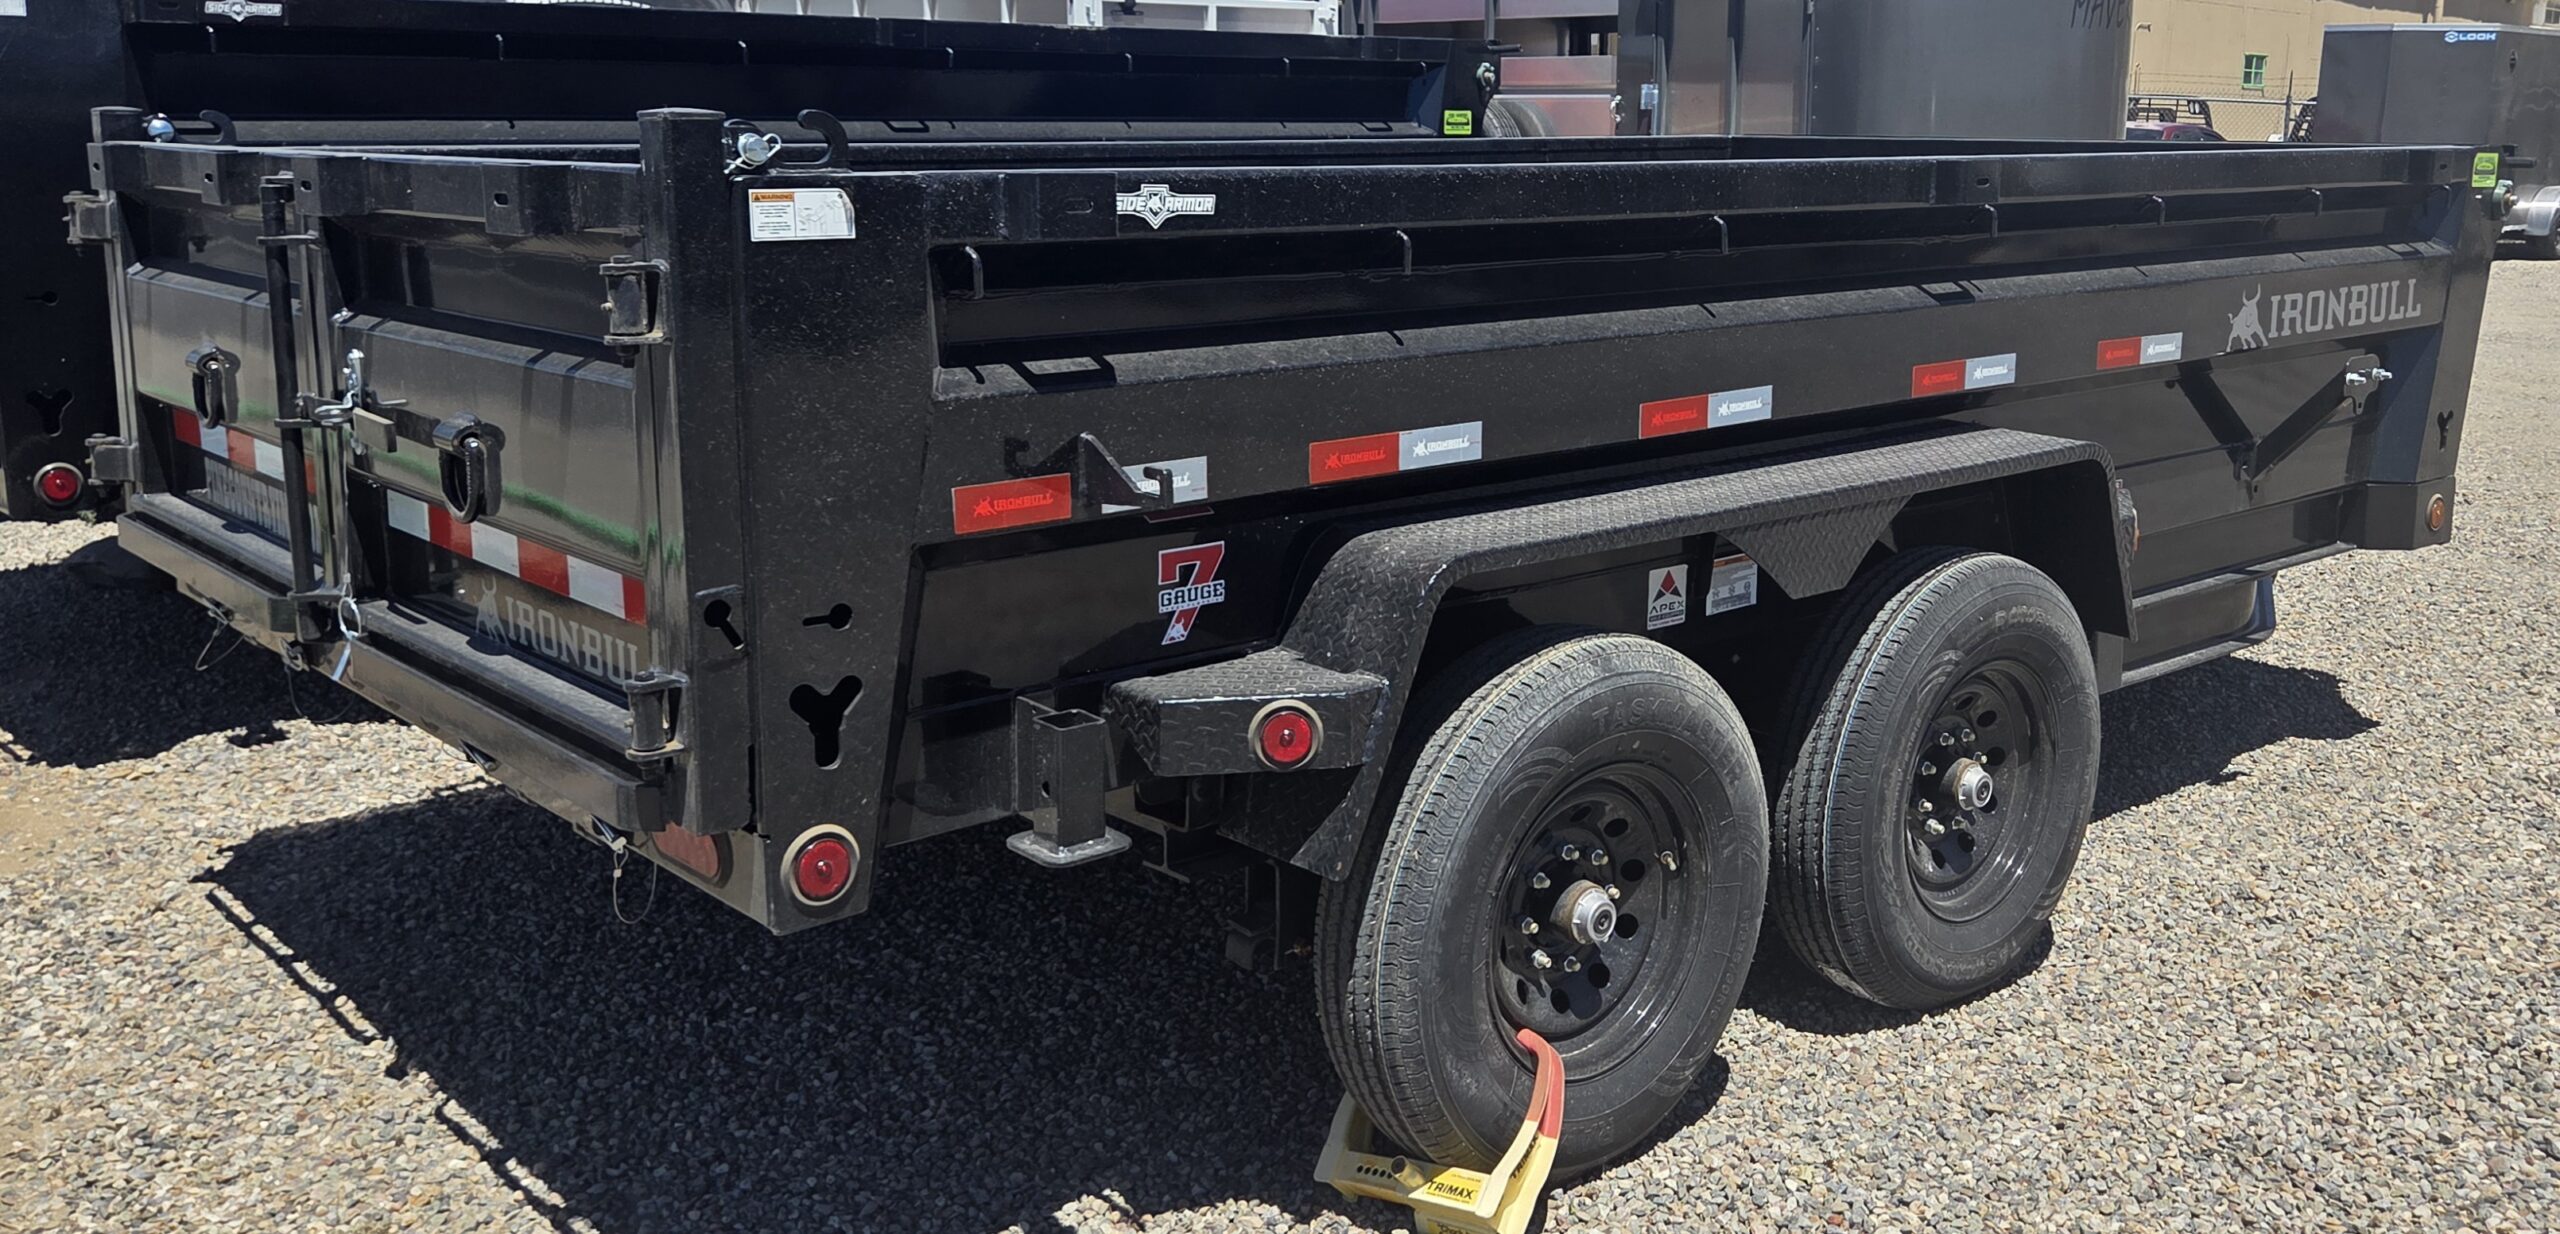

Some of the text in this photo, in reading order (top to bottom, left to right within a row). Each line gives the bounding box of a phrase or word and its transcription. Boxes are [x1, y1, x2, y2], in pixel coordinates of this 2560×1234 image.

[2459, 32, 2497, 41] LOOK
[1116, 196, 1214, 212] SIDE ARMOR
[2268, 278, 2421, 338] IRONBULL
[992, 487, 1054, 512] IRONBULL
[1160, 581, 1224, 608] GAUGE
[1649, 600, 1685, 615] APEX
[1427, 1180, 1473, 1200] TRIMAX
